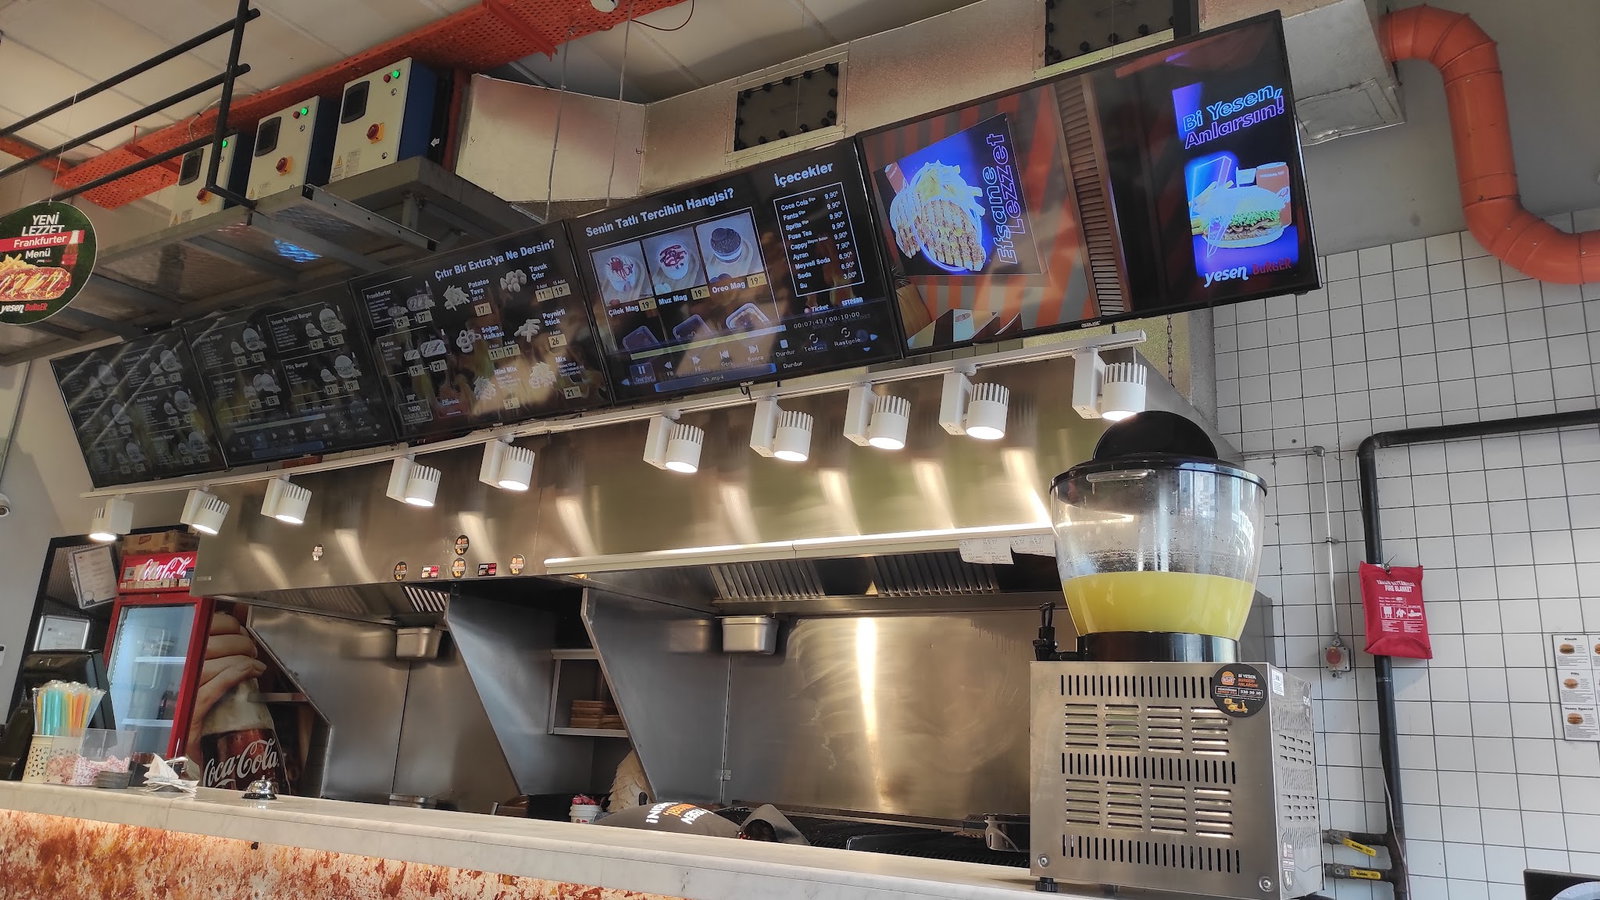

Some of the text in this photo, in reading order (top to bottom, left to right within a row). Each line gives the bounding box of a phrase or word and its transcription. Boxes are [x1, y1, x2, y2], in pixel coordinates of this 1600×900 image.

[1183, 85, 1282, 132] Bi Yesen,
[1185, 96, 1285, 150] Anlarsın!
[774, 163, 833, 187] İçecekler
[986, 134, 1025, 234] Lezzet
[781, 202, 796, 211] Coca
[796, 199, 809, 207] Cola
[32, 212, 60, 225] YENİ
[586, 188, 734, 237] Senin Tatlı Tercihin Hangisi?
[983, 166, 1018, 264] Efsane
[21, 225, 65, 237] LEZZET
[785, 222, 802, 231] Sprite
[14, 235, 67, 248] Frankfurter
[790, 241, 808, 250] Cappy
[25, 248, 51, 259] Menü
[793, 252, 809, 260] Ayran
[435, 239, 555, 281] Çıtır Bir Extra'ya Ne Dersin?
[816, 256, 831, 265] Soda
[529, 263, 548, 273] Tavuk
[797, 271, 812, 280] Soda
[1204, 266, 1249, 288] yesen
[467, 278, 490, 289] Patates
[711, 281, 746, 294] Oreo Mag
[658, 294, 688, 306] Muz Mag
[0, 304, 24, 313] yesen
[608, 305, 639, 317] Çilek Mag
[544, 318, 561, 327] Stick
[203, 738, 278, 787] Coca-Cola
